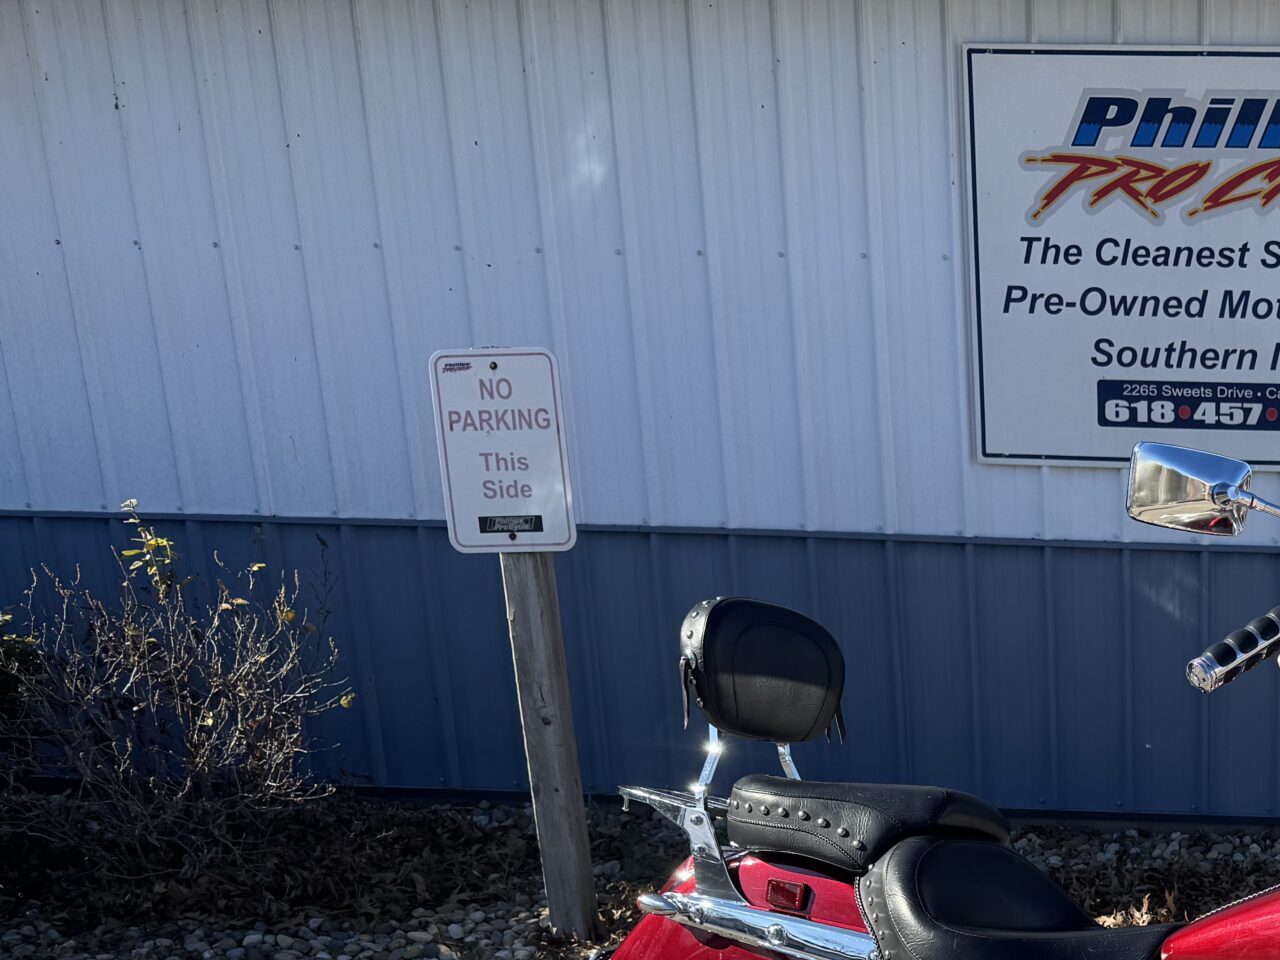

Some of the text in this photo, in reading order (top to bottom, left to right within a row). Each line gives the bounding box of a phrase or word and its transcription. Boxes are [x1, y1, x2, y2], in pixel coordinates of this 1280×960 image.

[1025, 153, 1213, 219] PRO
[1020, 237, 1083, 266] The
[1095, 238, 1250, 268] Cleanest
[1002, 285, 1209, 318] Pre-Owned
[1090, 338, 1258, 370] Southern
[478, 377, 513, 400] NO
[1122, 384, 1158, 397] 2265
[1161, 385, 1213, 398] Sweets
[1217, 386, 1253, 399] Drive
[447, 408, 552, 432] PARKING
[479, 452, 530, 472] This
[482, 479, 533, 500] Side
